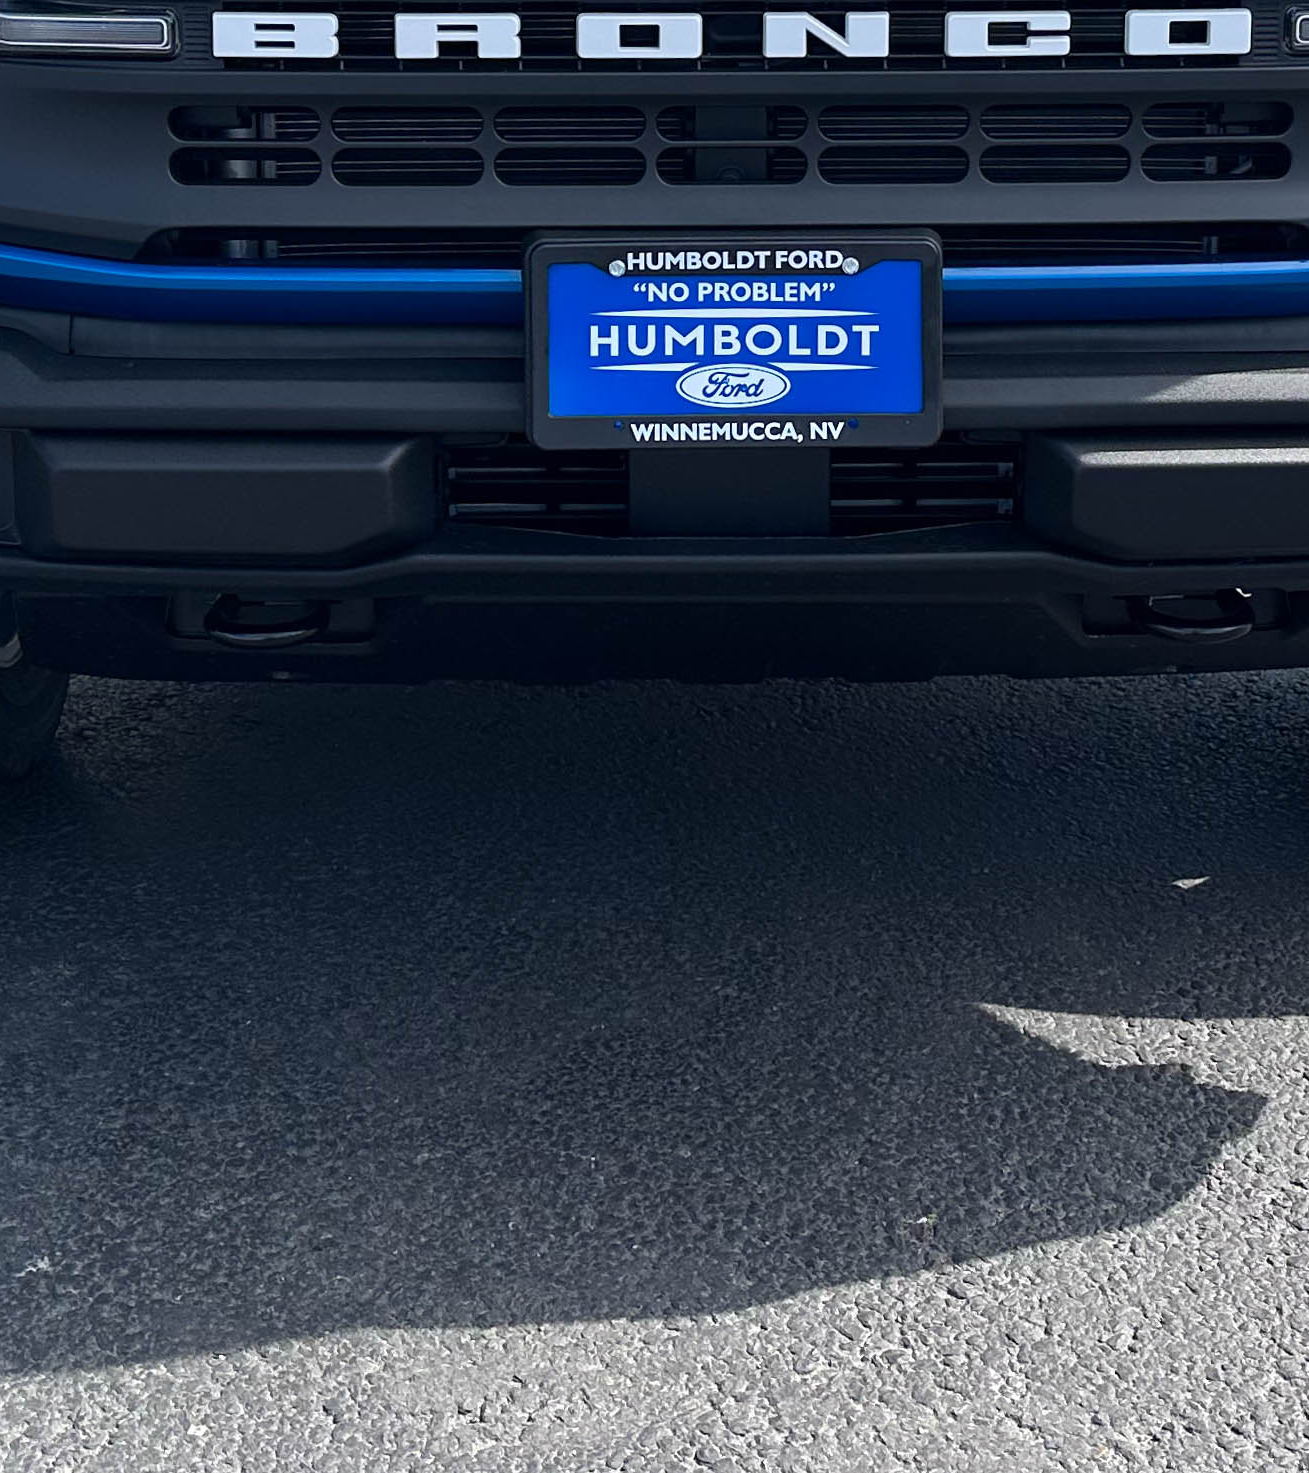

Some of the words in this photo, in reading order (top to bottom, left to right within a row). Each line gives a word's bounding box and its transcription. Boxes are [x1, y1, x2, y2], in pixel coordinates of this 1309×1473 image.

[212, 8, 1253, 60] BRONCO
[627, 250, 771, 272] HUMBOLDT
[775, 249, 843, 270] FORD
[589, 324, 881, 357] HUMBOLDT
[702, 371, 765, 398] Ford
[630, 422, 804, 444] WINNEMUCCA,
[809, 421, 846, 440] NV
